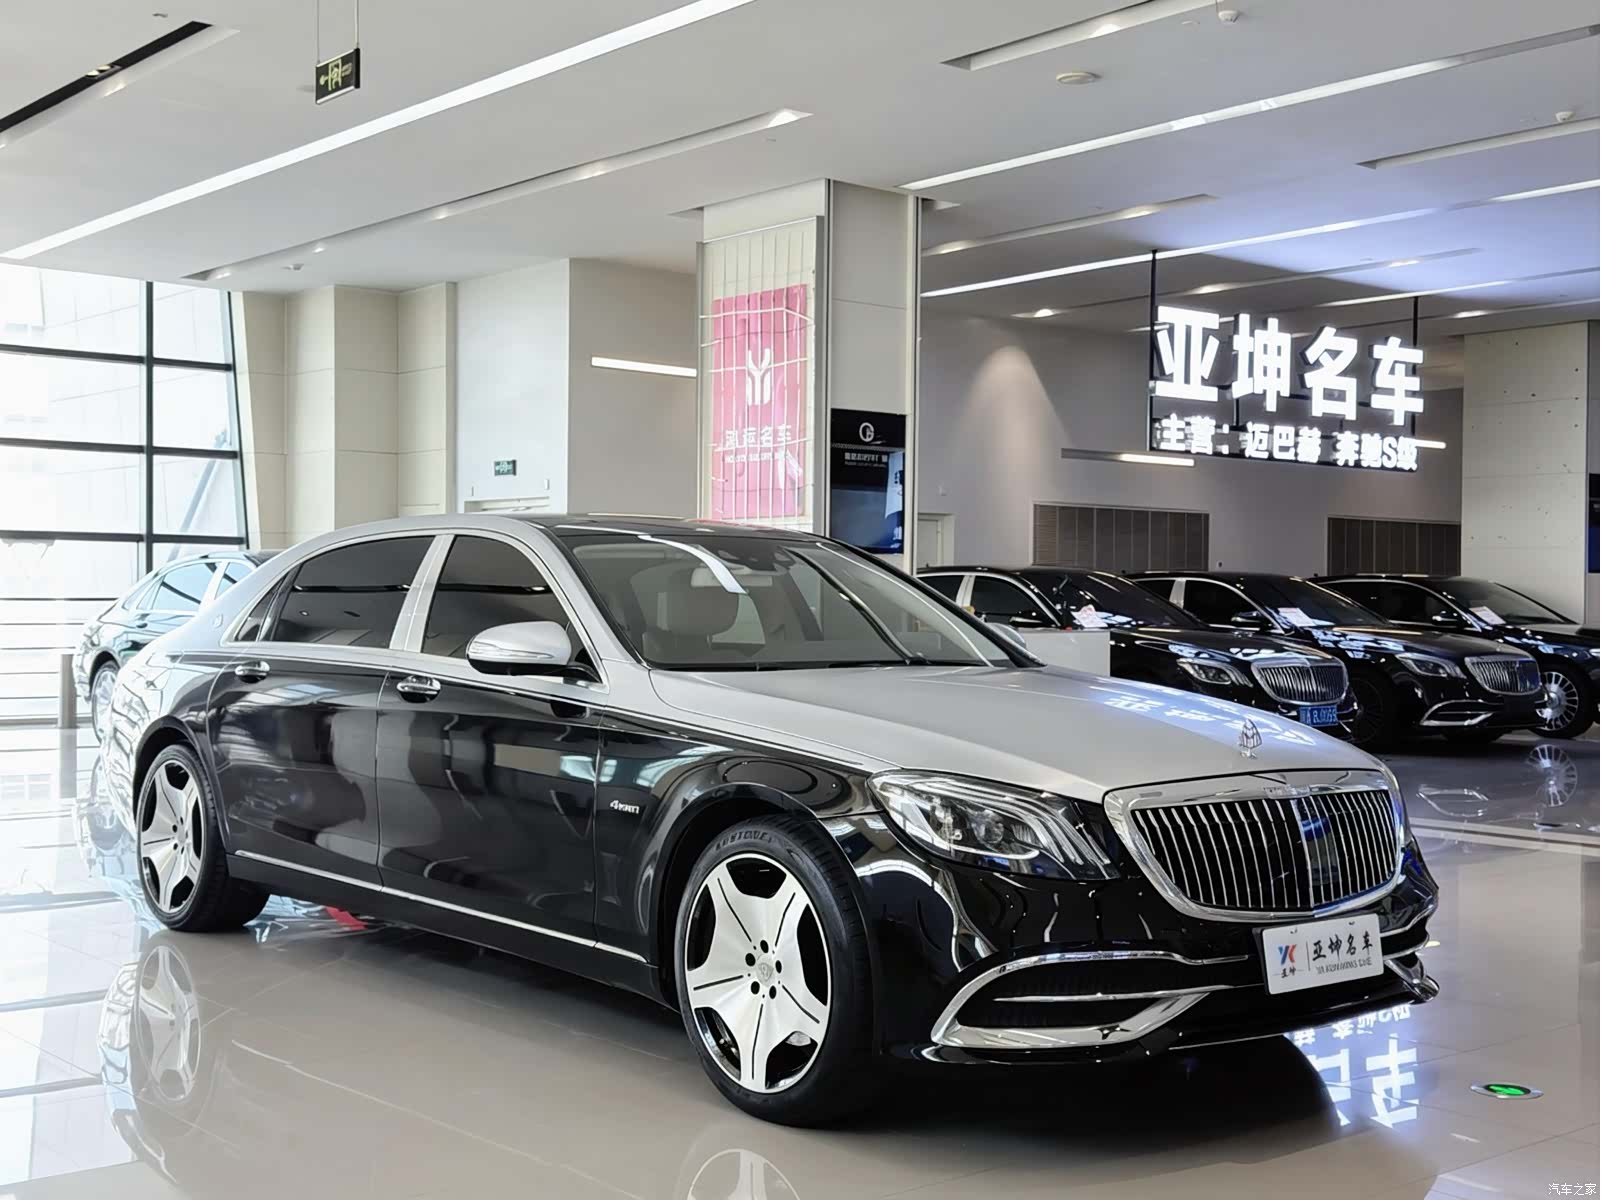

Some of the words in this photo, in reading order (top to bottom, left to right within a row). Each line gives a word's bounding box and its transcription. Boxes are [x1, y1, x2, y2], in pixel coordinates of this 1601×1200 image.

[1155, 305, 1424, 427] 亚坤名车
[1246, 421, 1322, 464] 迈巴赫
[1335, 431, 1418, 471] 奔驰S级
[1312, 930, 1374, 962] 亚坤名车
[1281, 966, 1297, 979] 亚坤
